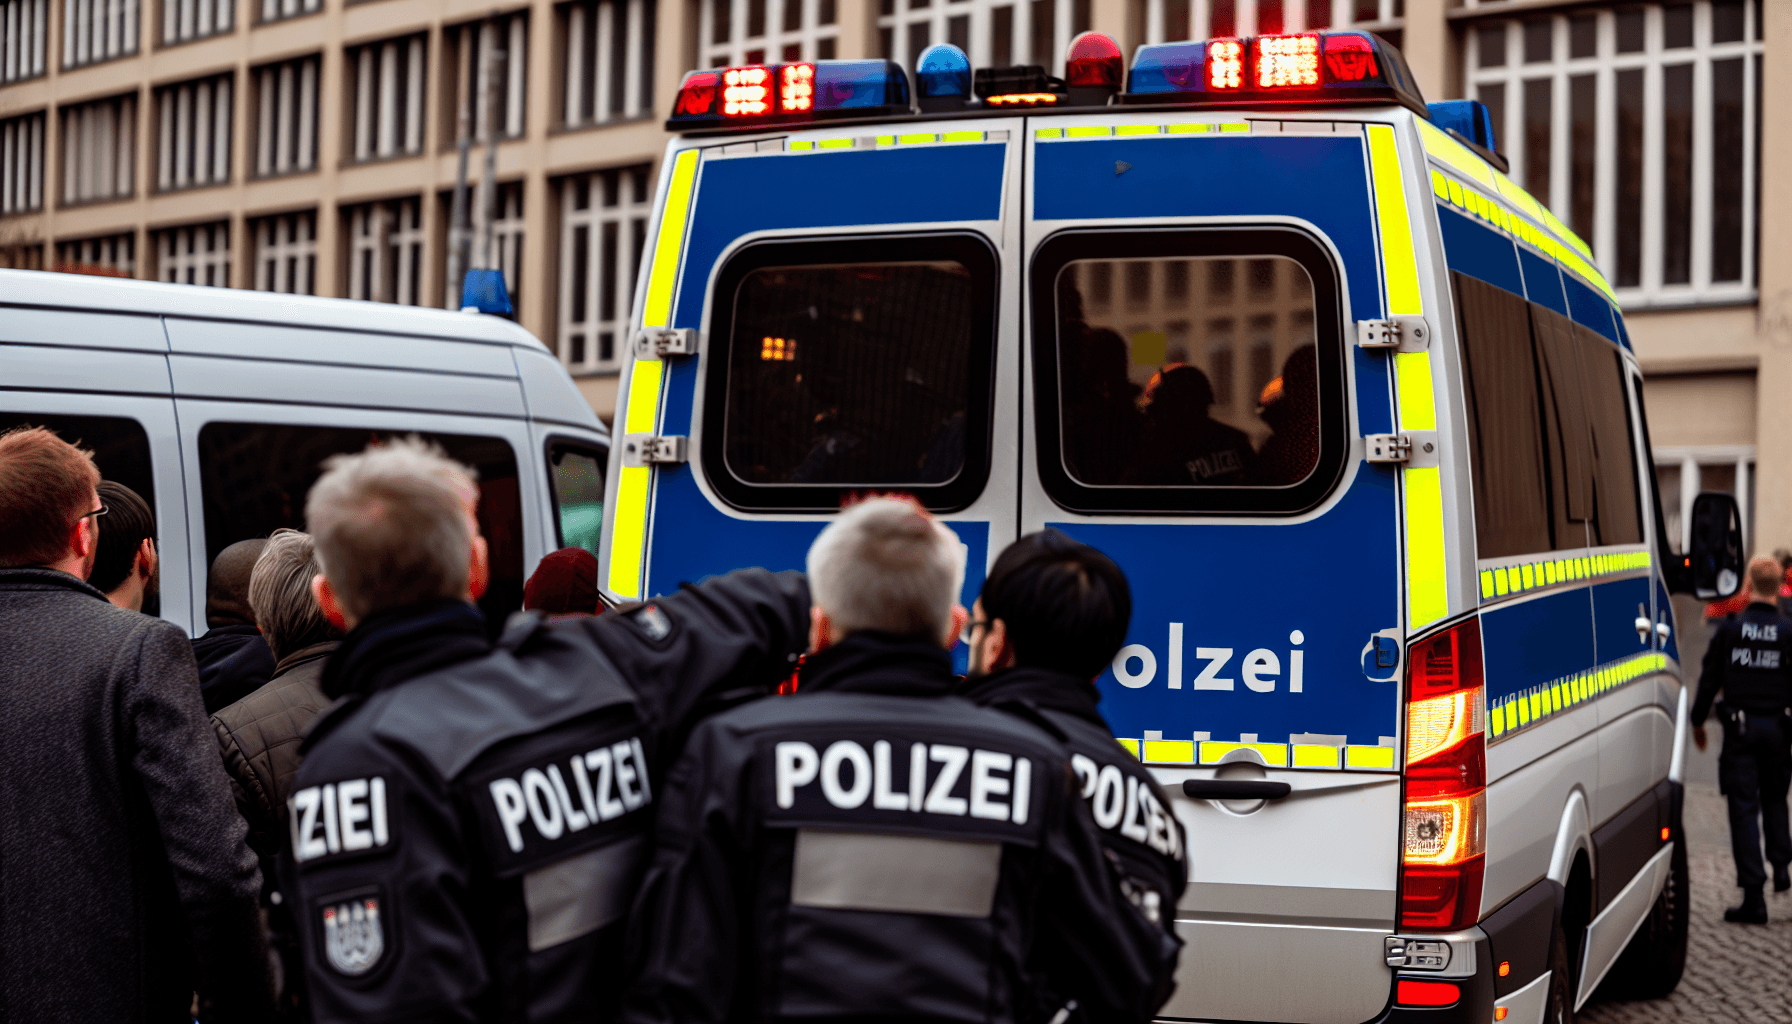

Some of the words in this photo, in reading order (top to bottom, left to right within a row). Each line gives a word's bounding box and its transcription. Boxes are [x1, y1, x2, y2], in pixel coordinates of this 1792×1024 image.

[1111, 622, 1305, 693] olzei
[286, 776, 389, 864] ZIEI
[489, 736, 652, 853] POLIZEI
[775, 740, 1032, 825] POLIZEI
